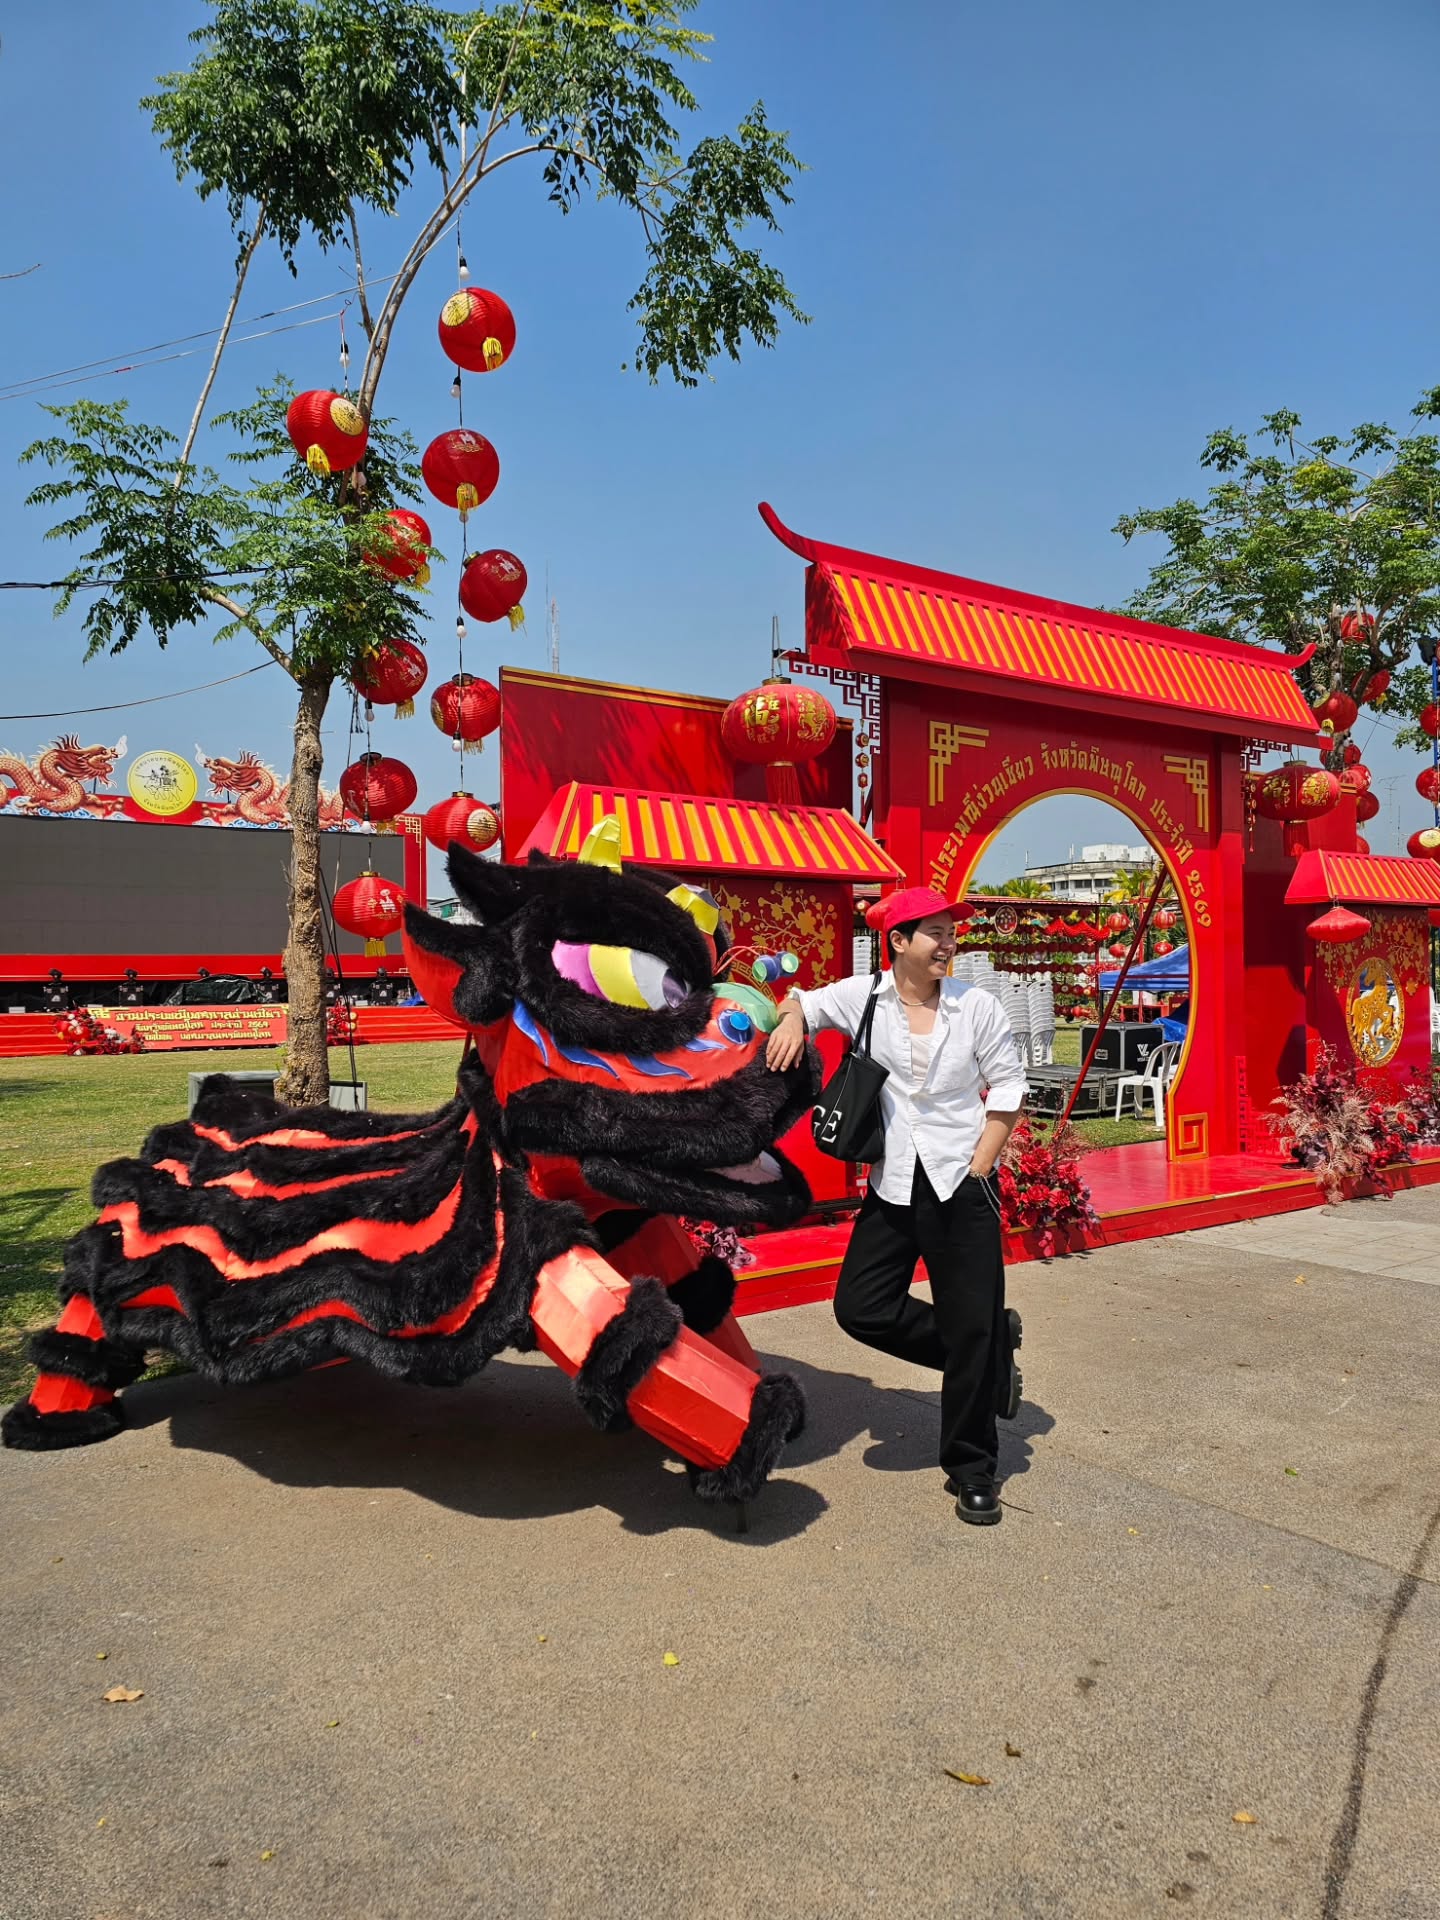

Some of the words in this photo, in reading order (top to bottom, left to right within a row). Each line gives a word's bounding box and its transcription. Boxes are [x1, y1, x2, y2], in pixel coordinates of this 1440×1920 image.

[1040, 741, 1147, 802] จังหวัดพิษณุโลก
[1149, 798, 1195, 865] ประจำปี
[1185, 869, 1212, 929] 2569
